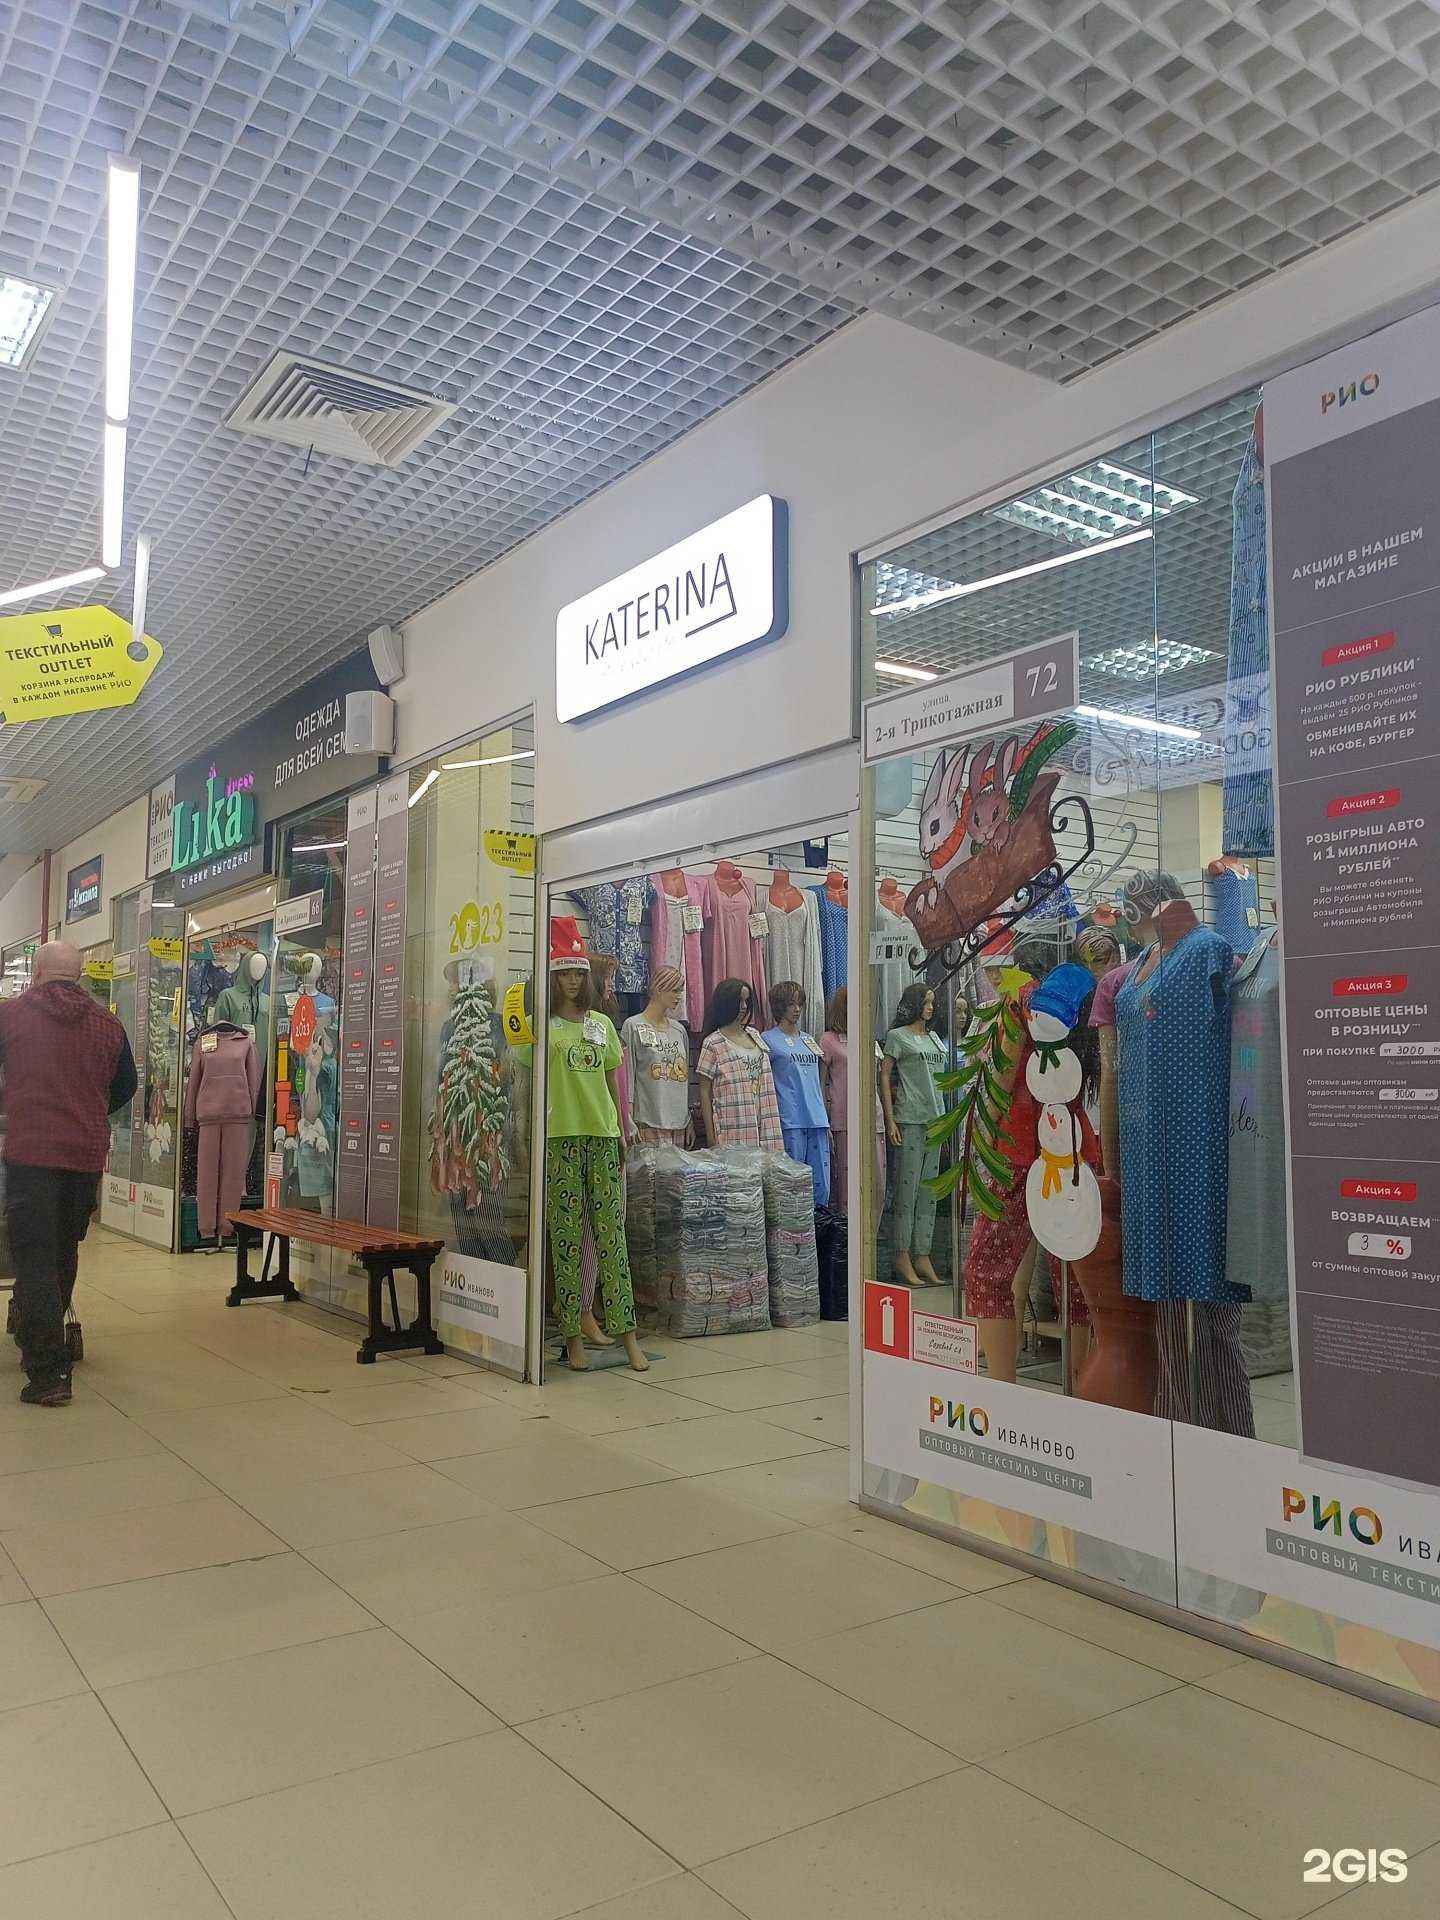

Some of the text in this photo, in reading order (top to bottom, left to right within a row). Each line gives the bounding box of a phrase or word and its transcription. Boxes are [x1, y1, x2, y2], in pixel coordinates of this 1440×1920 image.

[1320, 371, 1380, 416] РИО
[1291, 526, 1424, 581] АКЦИИ В НАШЕМ
[1314, 554, 1399, 591] МАГАЗИНЕ
[585, 553, 737, 665] KATERINA
[5, 634, 114, 661] ТЕКСТИЛЬНЫЙ
[1337, 639, 1379, 658] Акция 1
[39, 657, 92, 674] OUTLET
[21, 671, 116, 691] КОРЗИНА РАСПРОДАЖ
[1026, 662, 1058, 698] 72
[1305, 659, 1416, 697] РИО РУБЛИКИ
[22, 691, 61, 703] КАЖДОМ
[64, 683, 107, 696] МАГАЗИНЕ
[110, 679, 132, 689] РИО
[1349, 693, 1365, 703] 500
[922, 695, 950, 712] улица
[1351, 704, 1371, 715] РИО
[295, 698, 341, 741] ОДЕЖДА
[875, 692, 1003, 744] 2-я Трикотажная
[1306, 710, 1417, 742] ОБМЕНИВАЙТЕ ИХ
[1309, 727, 1415, 758] НА КОФЕ, БУРГЕР
[274, 731, 347, 789] ДЛЯ ВСЕЙ СЕМ
[1341, 795, 1385, 811] Акция 2
[1306, 818, 1425, 845] РОЗЫГРЫШ АВТО
[1325, 846, 1335, 860] 1
[1338, 838, 1418, 858] МИЛЛИОНА
[1320, 885, 1332, 894] Вы
[311, 901, 320, 915] 66
[1313, 897, 1332, 906] РИО
[1366, 899, 1423, 912] Автомобиля
[449, 902, 503, 954] 2023
[1348, 980, 1392, 992] Акция 3
[1314, 1004, 1428, 1020] ОПТОВЫЕ ЦЕНЫ
[296, 1022, 310, 1037] 2023
[1331, 1023, 1410, 1036] В РОЗНИЦУ
[1303, 1048, 1323, 1057] ПРИ
[1326, 1047, 1376, 1056] ПОКУПКЕ
[1396, 1045, 1425, 1055] 3000
[1355, 1184, 1402, 1196] Акция 4
[1331, 1210, 1431, 1228] ВОЗВРАЩАЕМ
[1360, 1234, 1404, 1255] 3 %
[444, 1269, 466, 1290] РИО
[1312, 1261, 1323, 1269] от
[1325, 1261, 1360, 1274] суммы
[1363, 1266, 1409, 1279] оптовой
[929, 1396, 1075, 1460] РИО ИВАНОВО
[925, 1437, 1086, 1491] ОПТОВЫЙ ТЕКСТИЛЬ ЦЕНТР
[1282, 1487, 1440, 1563] РИО ИВ
[1275, 1537, 1358, 1573] ОПТОВЫЙ
